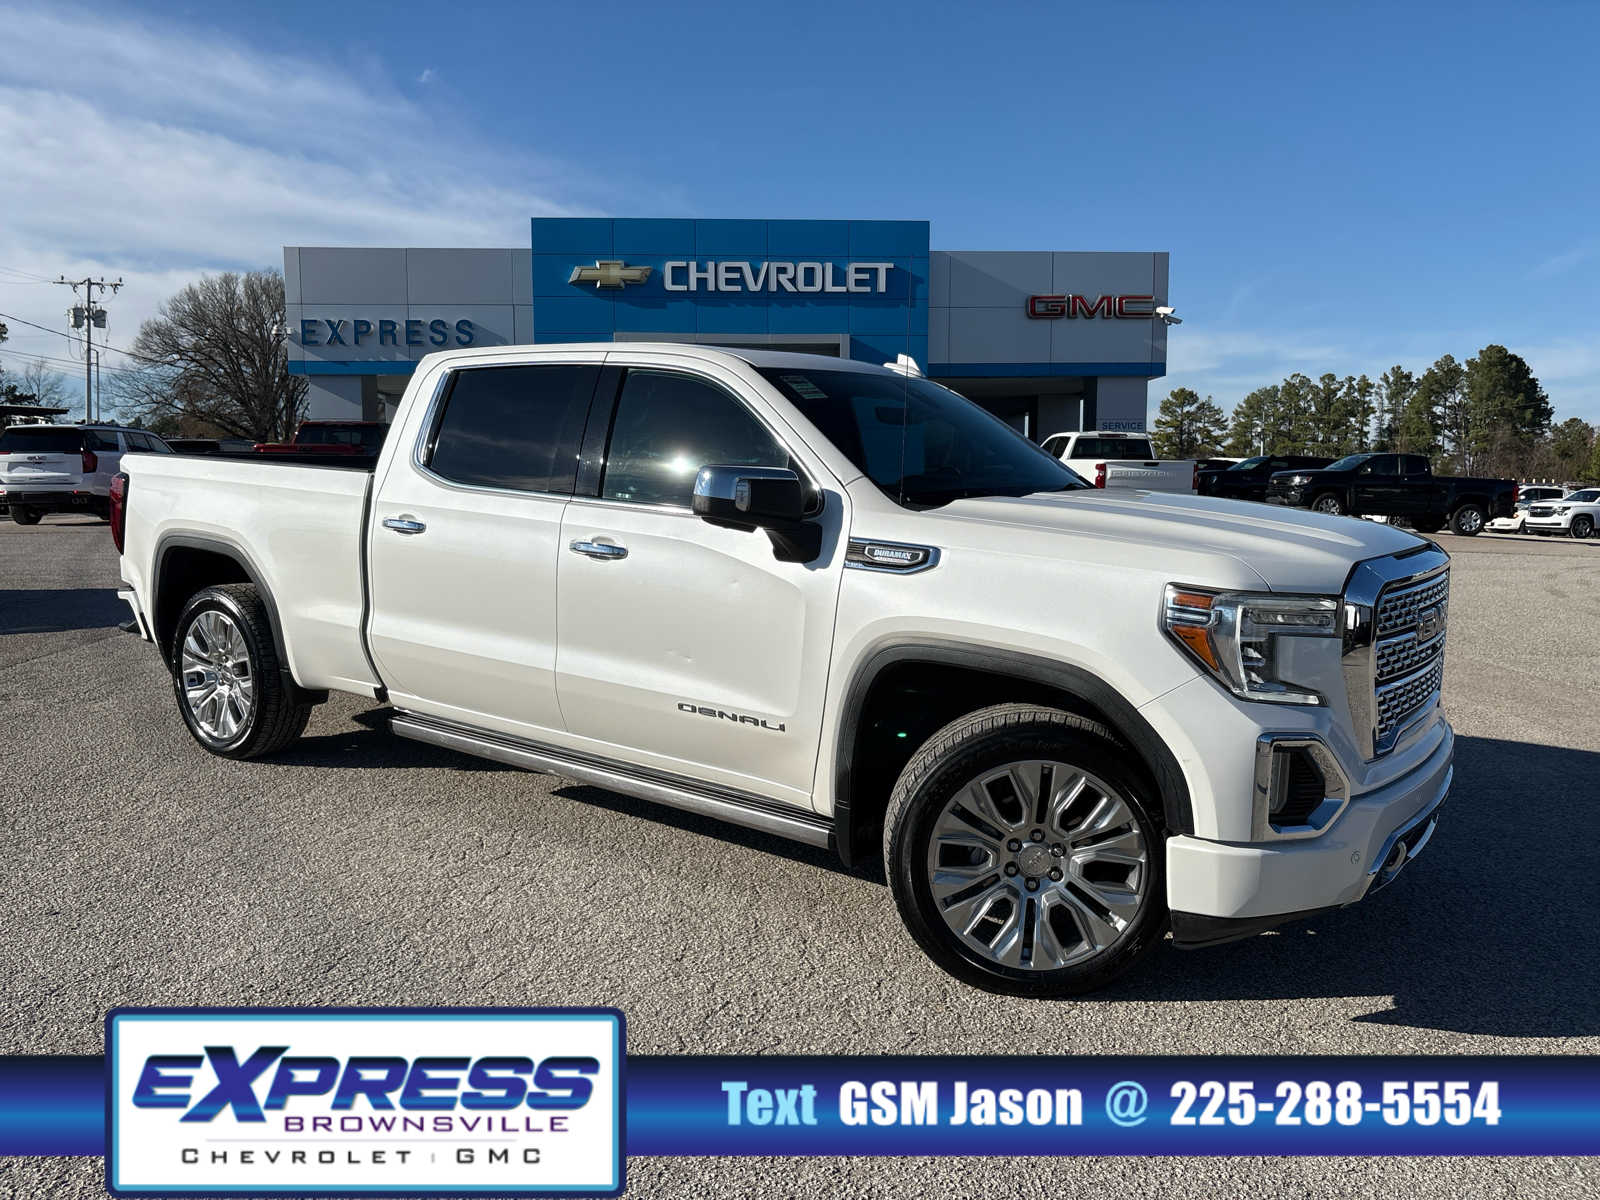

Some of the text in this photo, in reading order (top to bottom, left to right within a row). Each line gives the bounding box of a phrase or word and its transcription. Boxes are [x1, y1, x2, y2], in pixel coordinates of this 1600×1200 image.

[664, 260, 895, 294] CHEVROLET
[1027, 294, 1155, 319] GMC
[300, 318, 476, 347] EXPRESS
[1102, 421, 1145, 430] SERVICE
[873, 548, 912, 560] DURAMAX
[677, 702, 786, 733] DENALI
